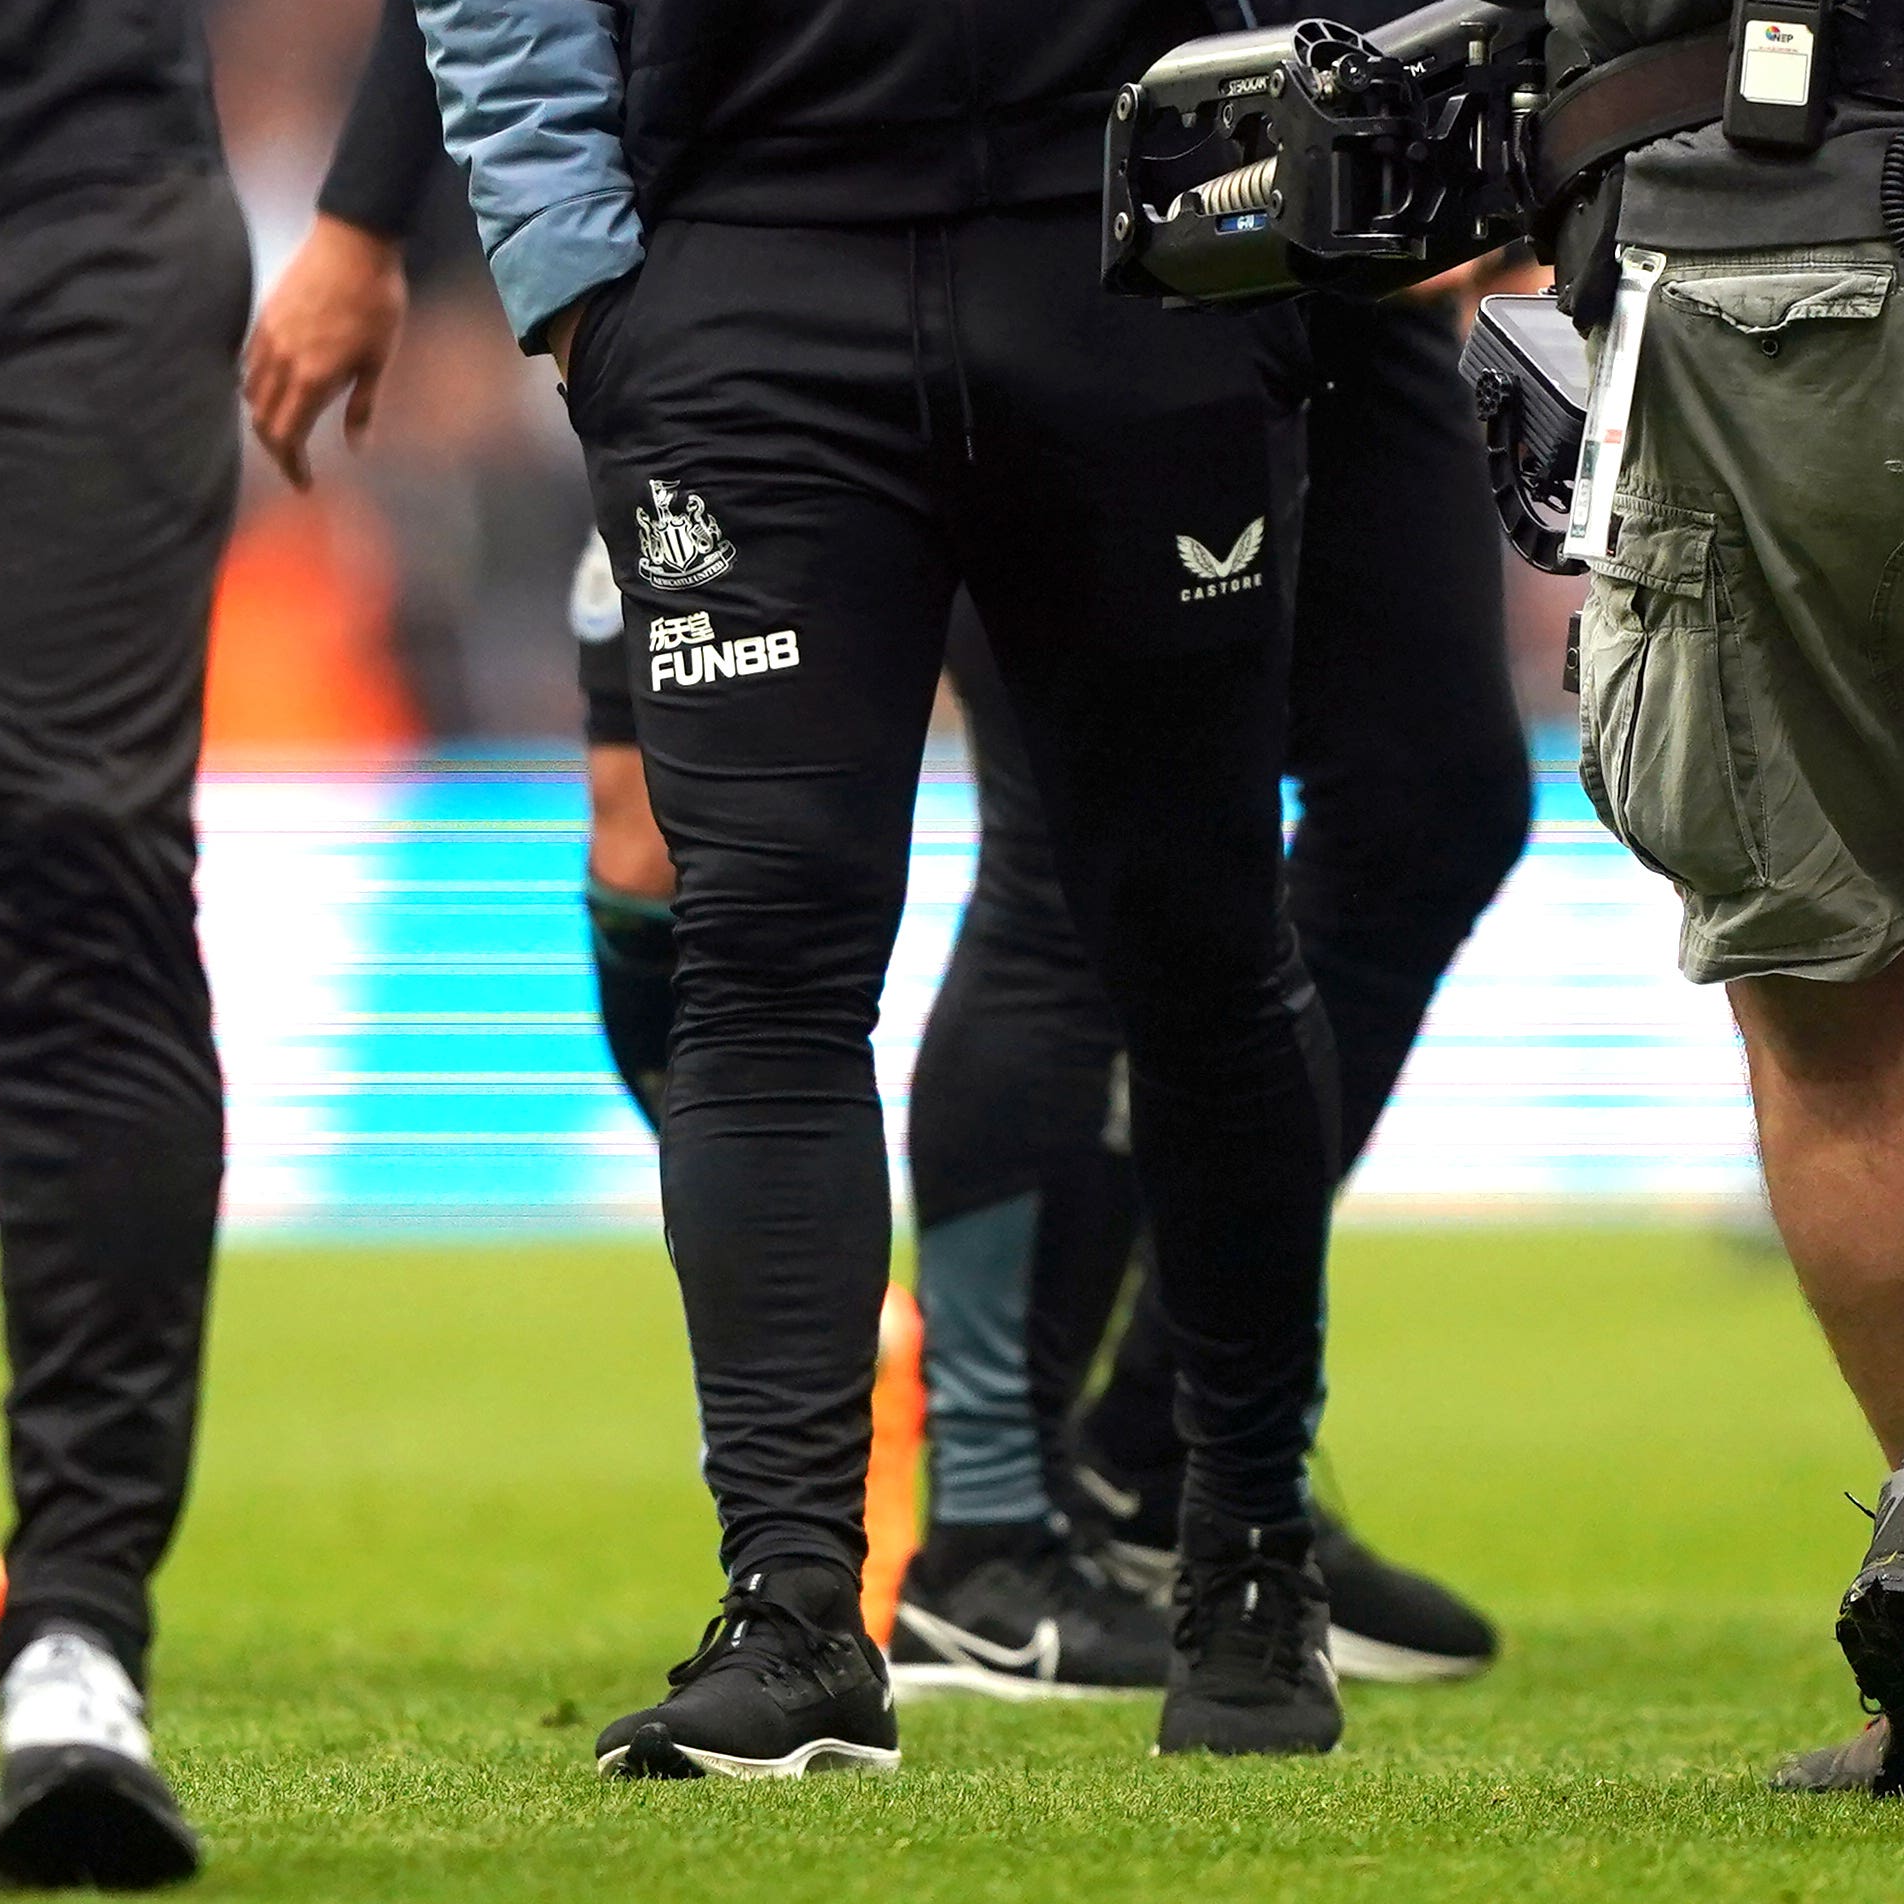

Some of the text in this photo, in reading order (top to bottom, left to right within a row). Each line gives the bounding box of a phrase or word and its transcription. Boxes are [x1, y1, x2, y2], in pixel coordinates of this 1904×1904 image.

[1181, 573, 1262, 602] CASTORE
[649, 611, 715, 652] 乐天堂
[651, 630, 800, 692] FUN88
